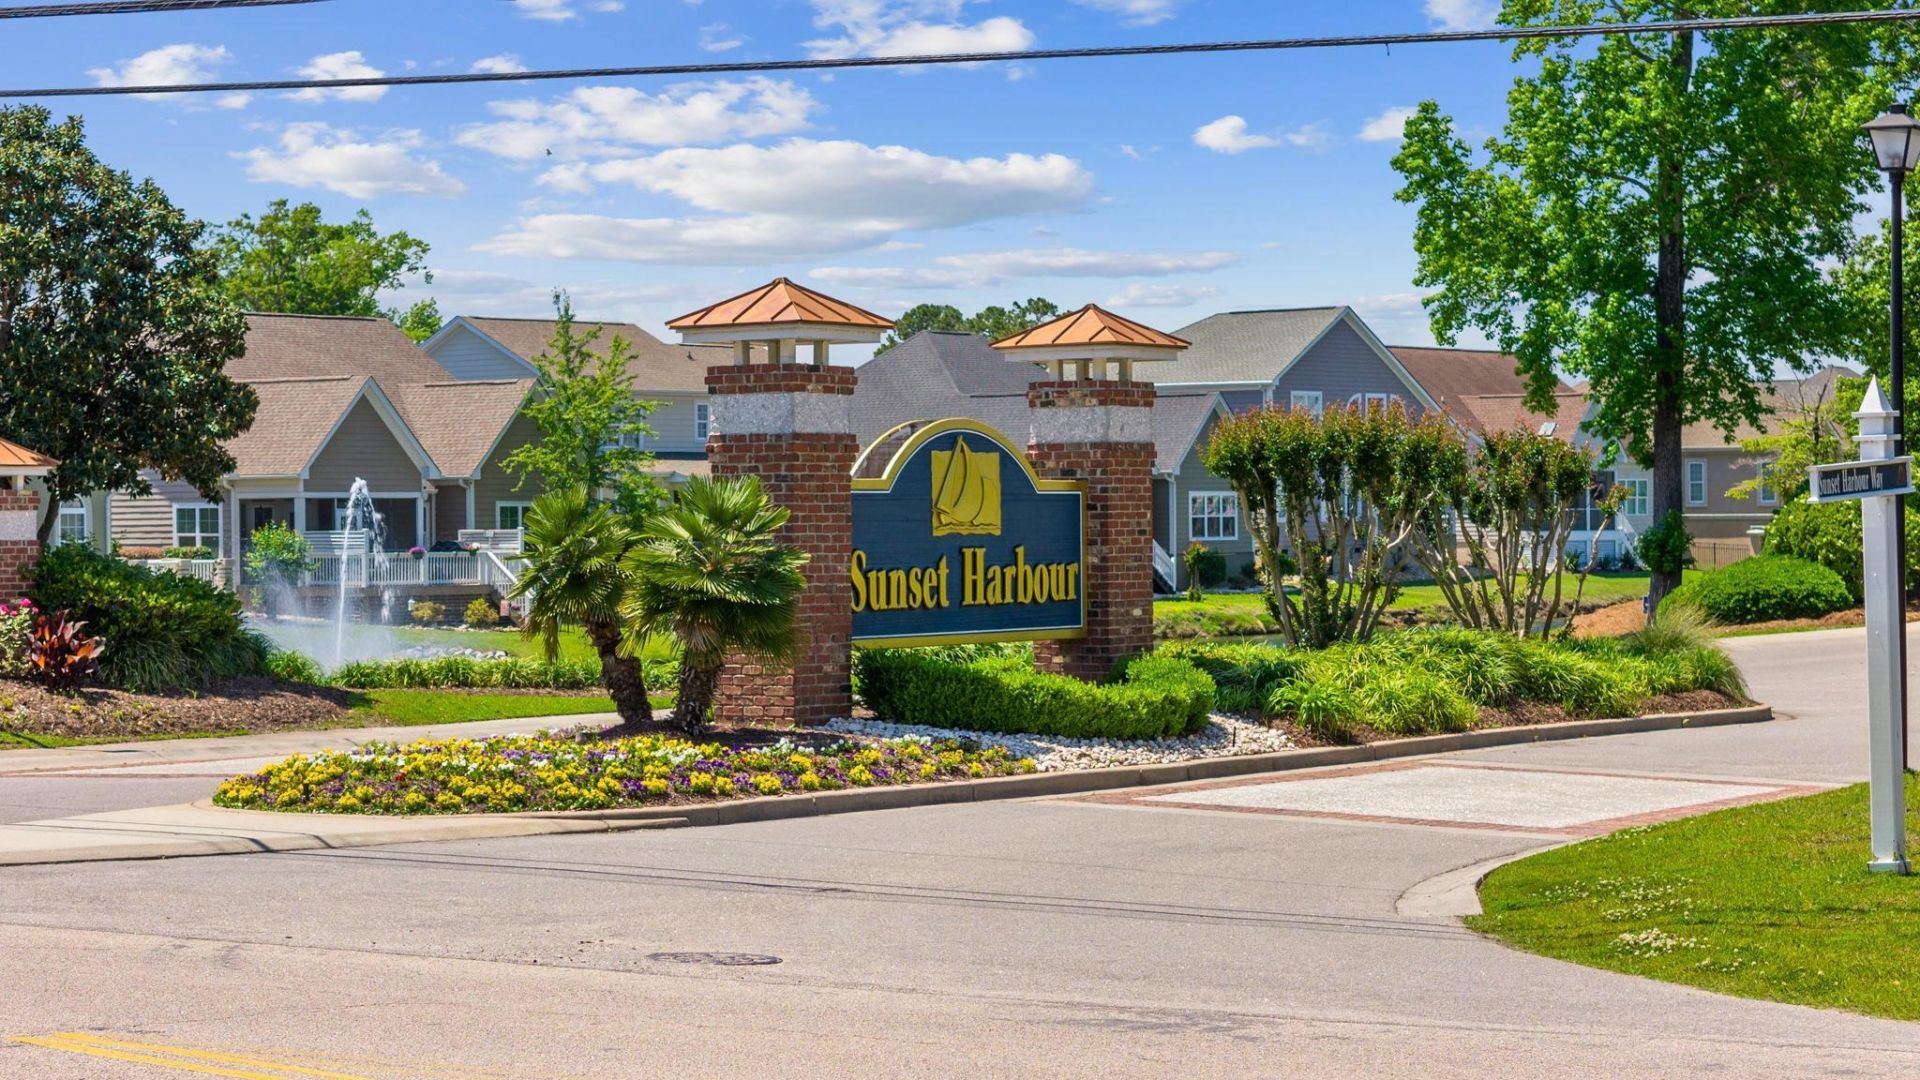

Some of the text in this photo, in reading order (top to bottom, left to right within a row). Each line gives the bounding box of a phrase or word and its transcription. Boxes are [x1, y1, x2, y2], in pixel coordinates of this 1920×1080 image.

[1842, 468, 1869, 492] Harbour
[1870, 465, 1884, 490] Way
[851, 545, 1079, 613] Sunset Harbour
